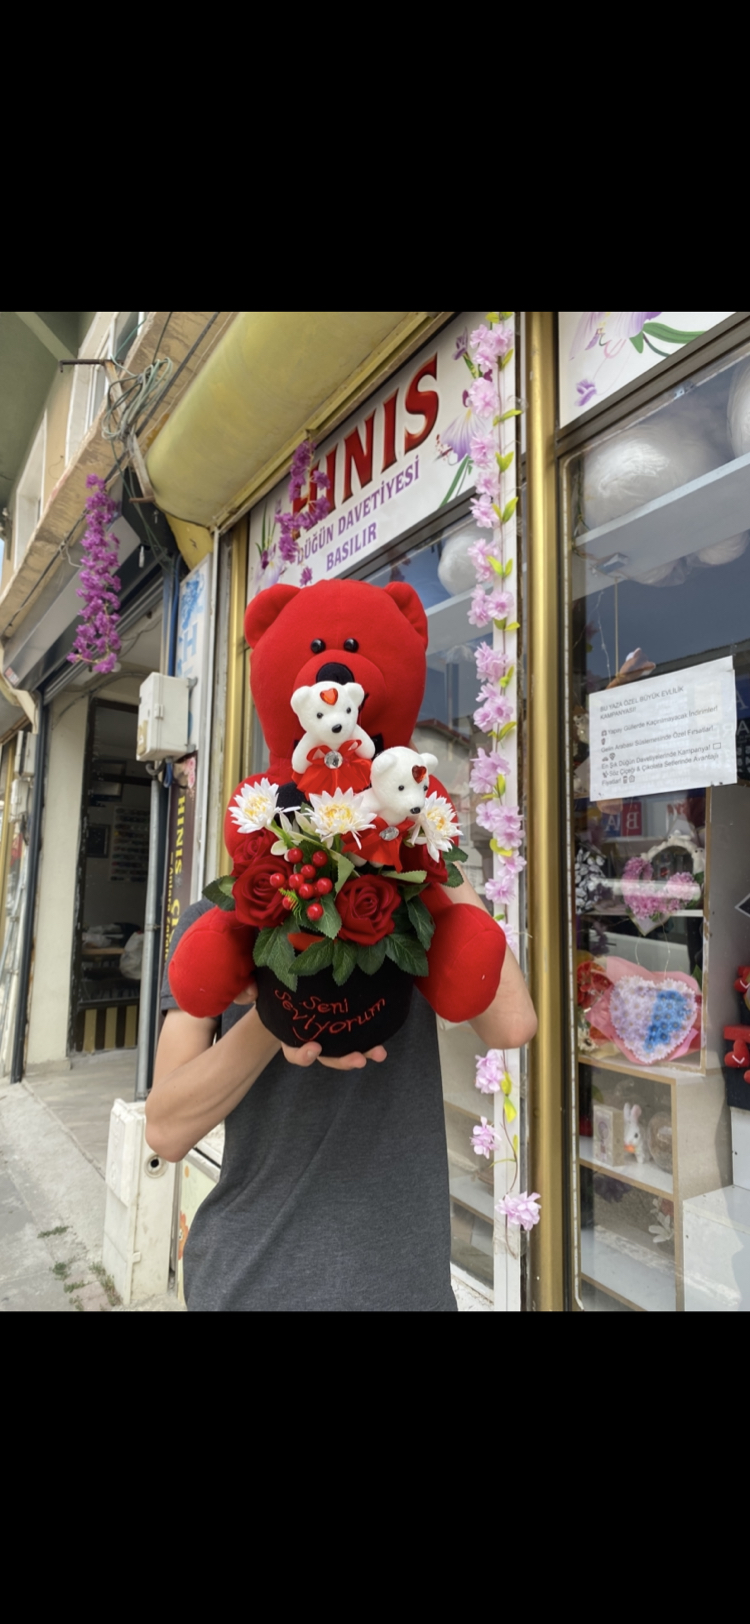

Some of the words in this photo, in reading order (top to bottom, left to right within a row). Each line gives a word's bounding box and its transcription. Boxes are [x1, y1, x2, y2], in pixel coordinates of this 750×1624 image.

[337, 454, 420, 537] DAVETİYESİ
[326, 520, 377, 573] BASILIR
[609, 701, 623, 709] YAZA
[624, 698, 639, 706] ÖZEL
[640, 692, 660, 703] BÜYÜK
[673, 730, 687, 739] Özel
[174, 795, 186, 875] HINIS
[302, 995, 349, 1015] Seni
